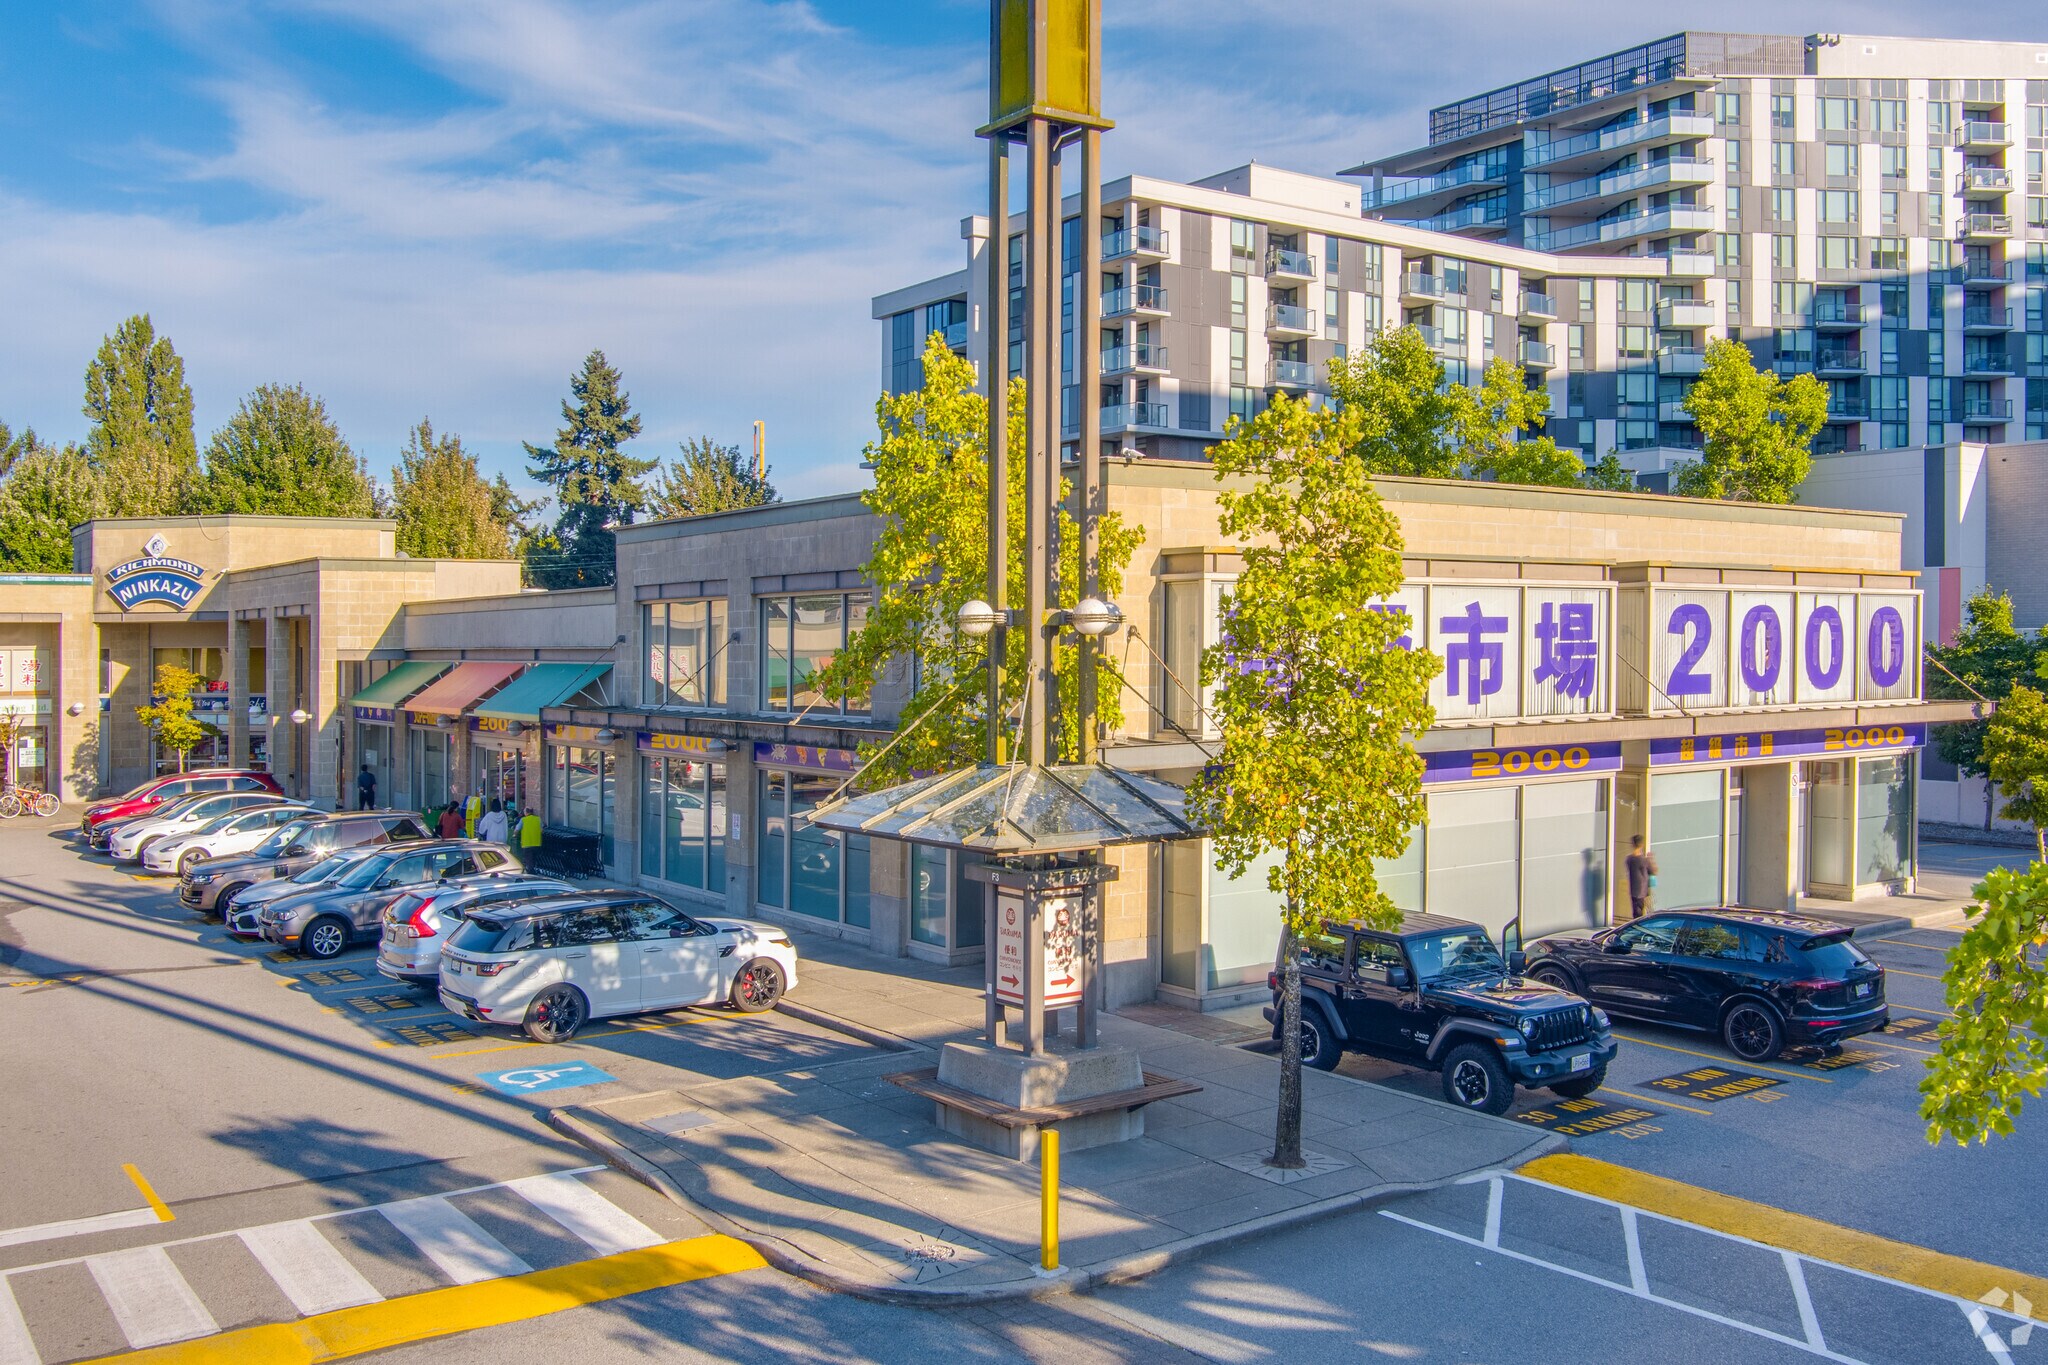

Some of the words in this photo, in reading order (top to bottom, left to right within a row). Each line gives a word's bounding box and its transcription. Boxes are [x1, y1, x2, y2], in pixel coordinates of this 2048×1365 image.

[116, 558, 199, 575] RICHMOND
[120, 579, 193, 602] NINKAZU
[1667, 603, 1905, 696] 2000
[479, 716, 512, 731] 200
[1680, 734, 1773, 761] 超級市場
[1825, 726, 1905, 750] 2000
[1471, 746, 1590, 777] 2000
[991, 872, 999, 881] F3
[1652, 1078, 1690, 1089] 30
[1682, 1068, 1730, 1082] MIN
[1688, 1076, 1779, 1101] PARKING
[1517, 1110, 1559, 1123] 30
[1555, 1098, 1607, 1113] MIN
[1553, 1108, 1656, 1136] PARKING
[1609, 1123, 1665, 1140] 200
